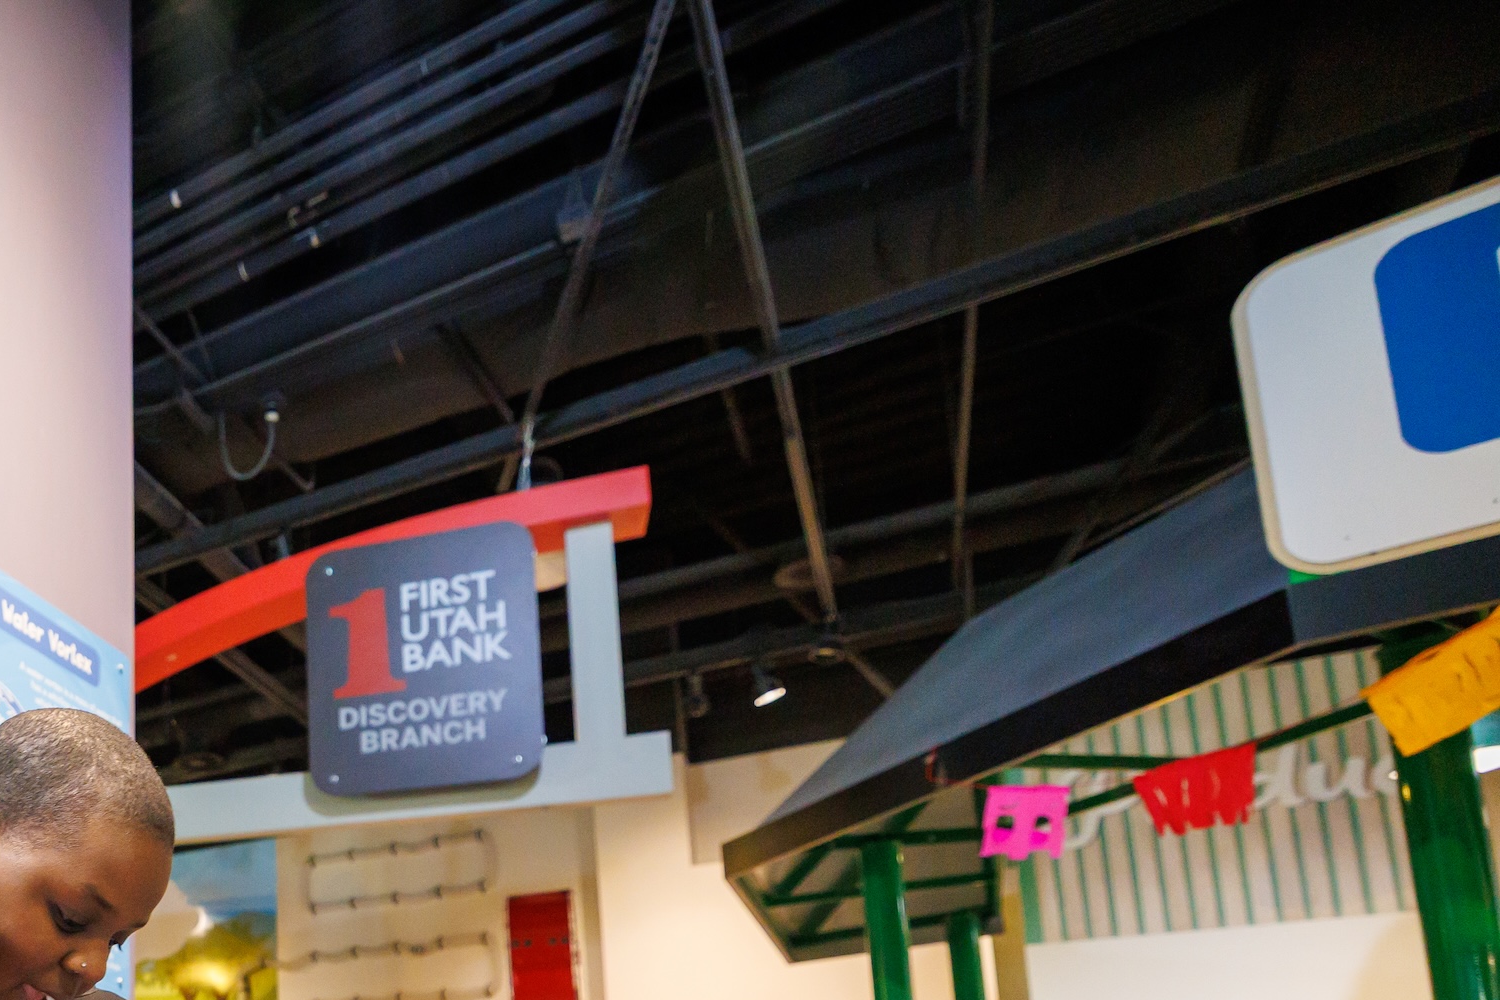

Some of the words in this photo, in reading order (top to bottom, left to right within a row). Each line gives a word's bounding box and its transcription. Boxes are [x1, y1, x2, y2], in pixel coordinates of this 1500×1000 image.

[400, 568, 496, 612] FIRST
[2, 599, 45, 642] Water
[48, 629, 92, 675] Vortex
[328, 587, 407, 699] 1
[401, 600, 507, 643] UTAH
[402, 631, 512, 673] BANK
[338, 687, 507, 731] DISCOVERY
[360, 718, 487, 754] BRANCH
